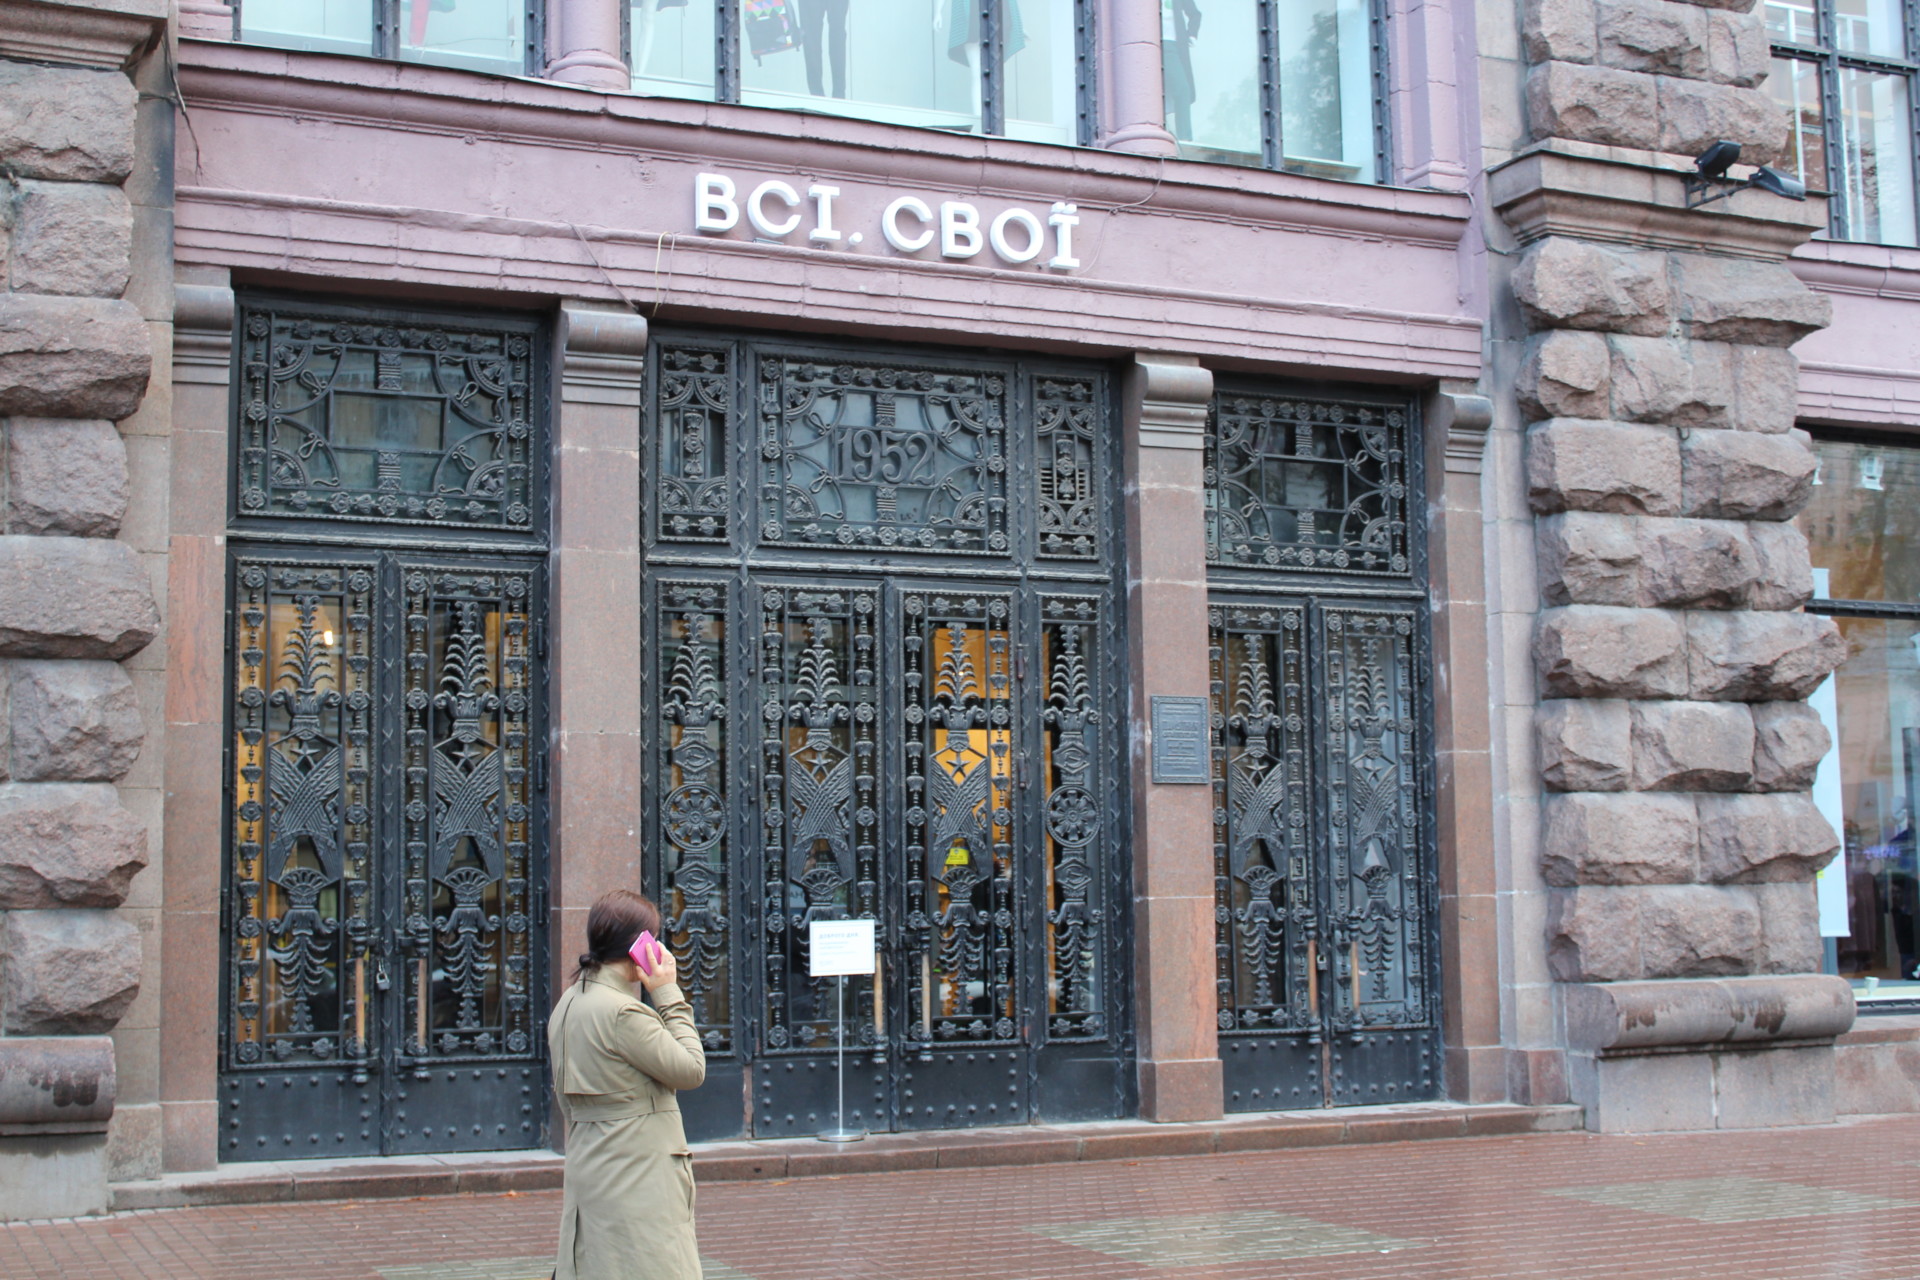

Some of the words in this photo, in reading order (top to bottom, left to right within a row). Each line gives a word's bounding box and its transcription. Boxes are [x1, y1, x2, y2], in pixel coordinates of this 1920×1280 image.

[695, 172, 864, 246] ВСІ.
[881, 196, 1081, 269] СВОЇ
[836, 427, 936, 486] 1952
